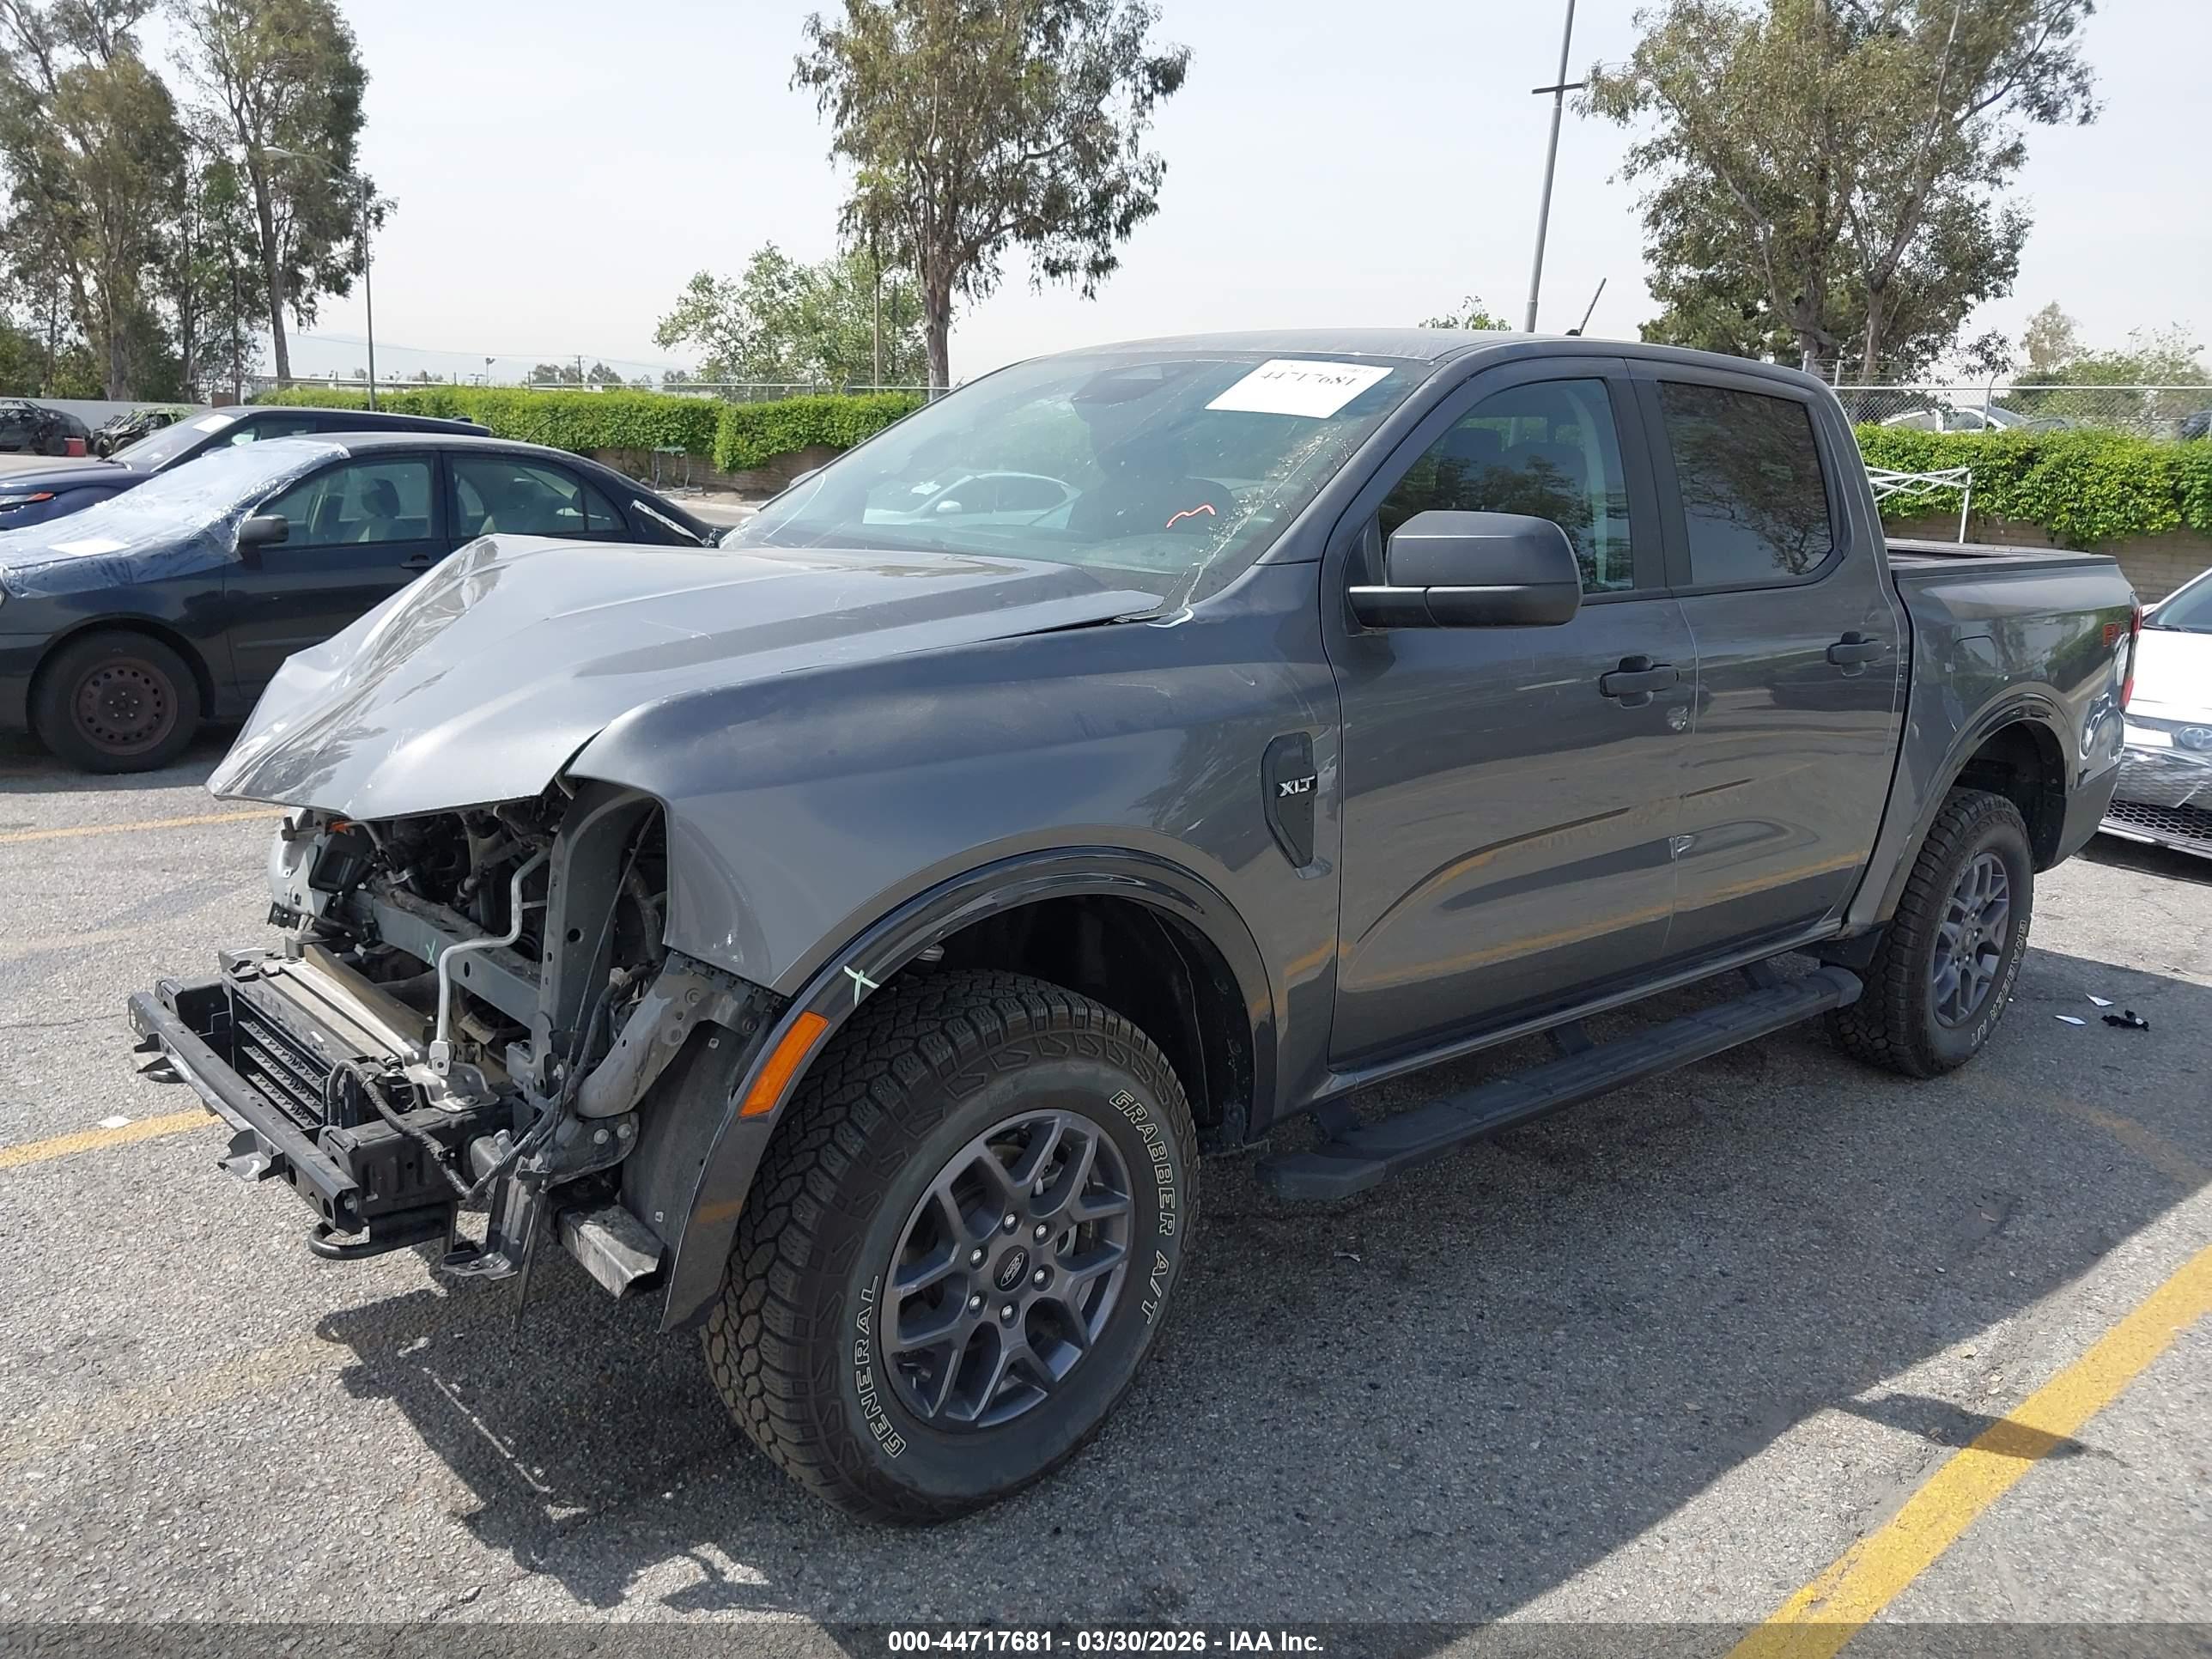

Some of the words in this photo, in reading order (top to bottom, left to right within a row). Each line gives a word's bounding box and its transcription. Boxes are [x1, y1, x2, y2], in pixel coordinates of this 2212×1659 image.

[1278, 775, 1316, 798] XLT
[1109, 1089, 1176, 1237] GRABBER
[1141, 1250, 1170, 1325] A/T
[854, 1275, 907, 1458] GENERAL
